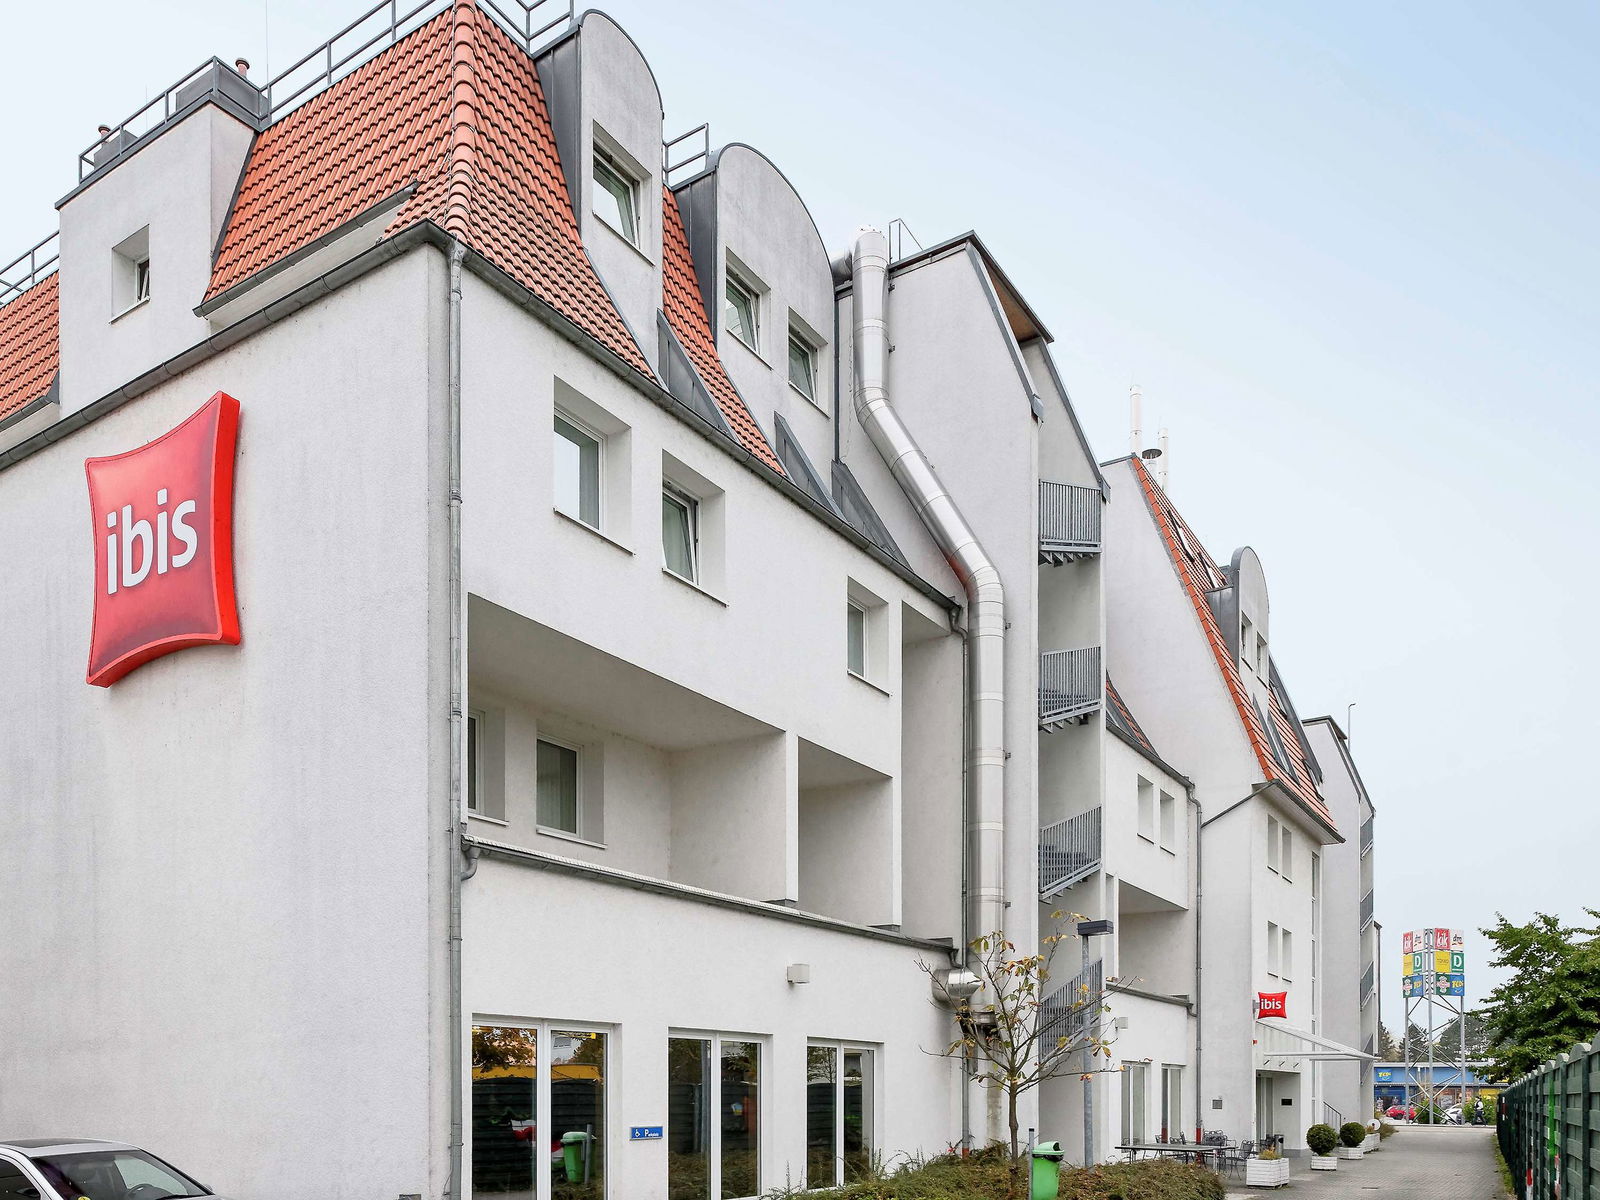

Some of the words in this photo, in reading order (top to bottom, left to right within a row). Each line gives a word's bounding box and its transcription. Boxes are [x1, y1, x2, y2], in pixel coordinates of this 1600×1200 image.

[107, 488, 198, 595] ibis
[1454, 955, 1462, 967] D
[1261, 998, 1282, 1010] ibis
